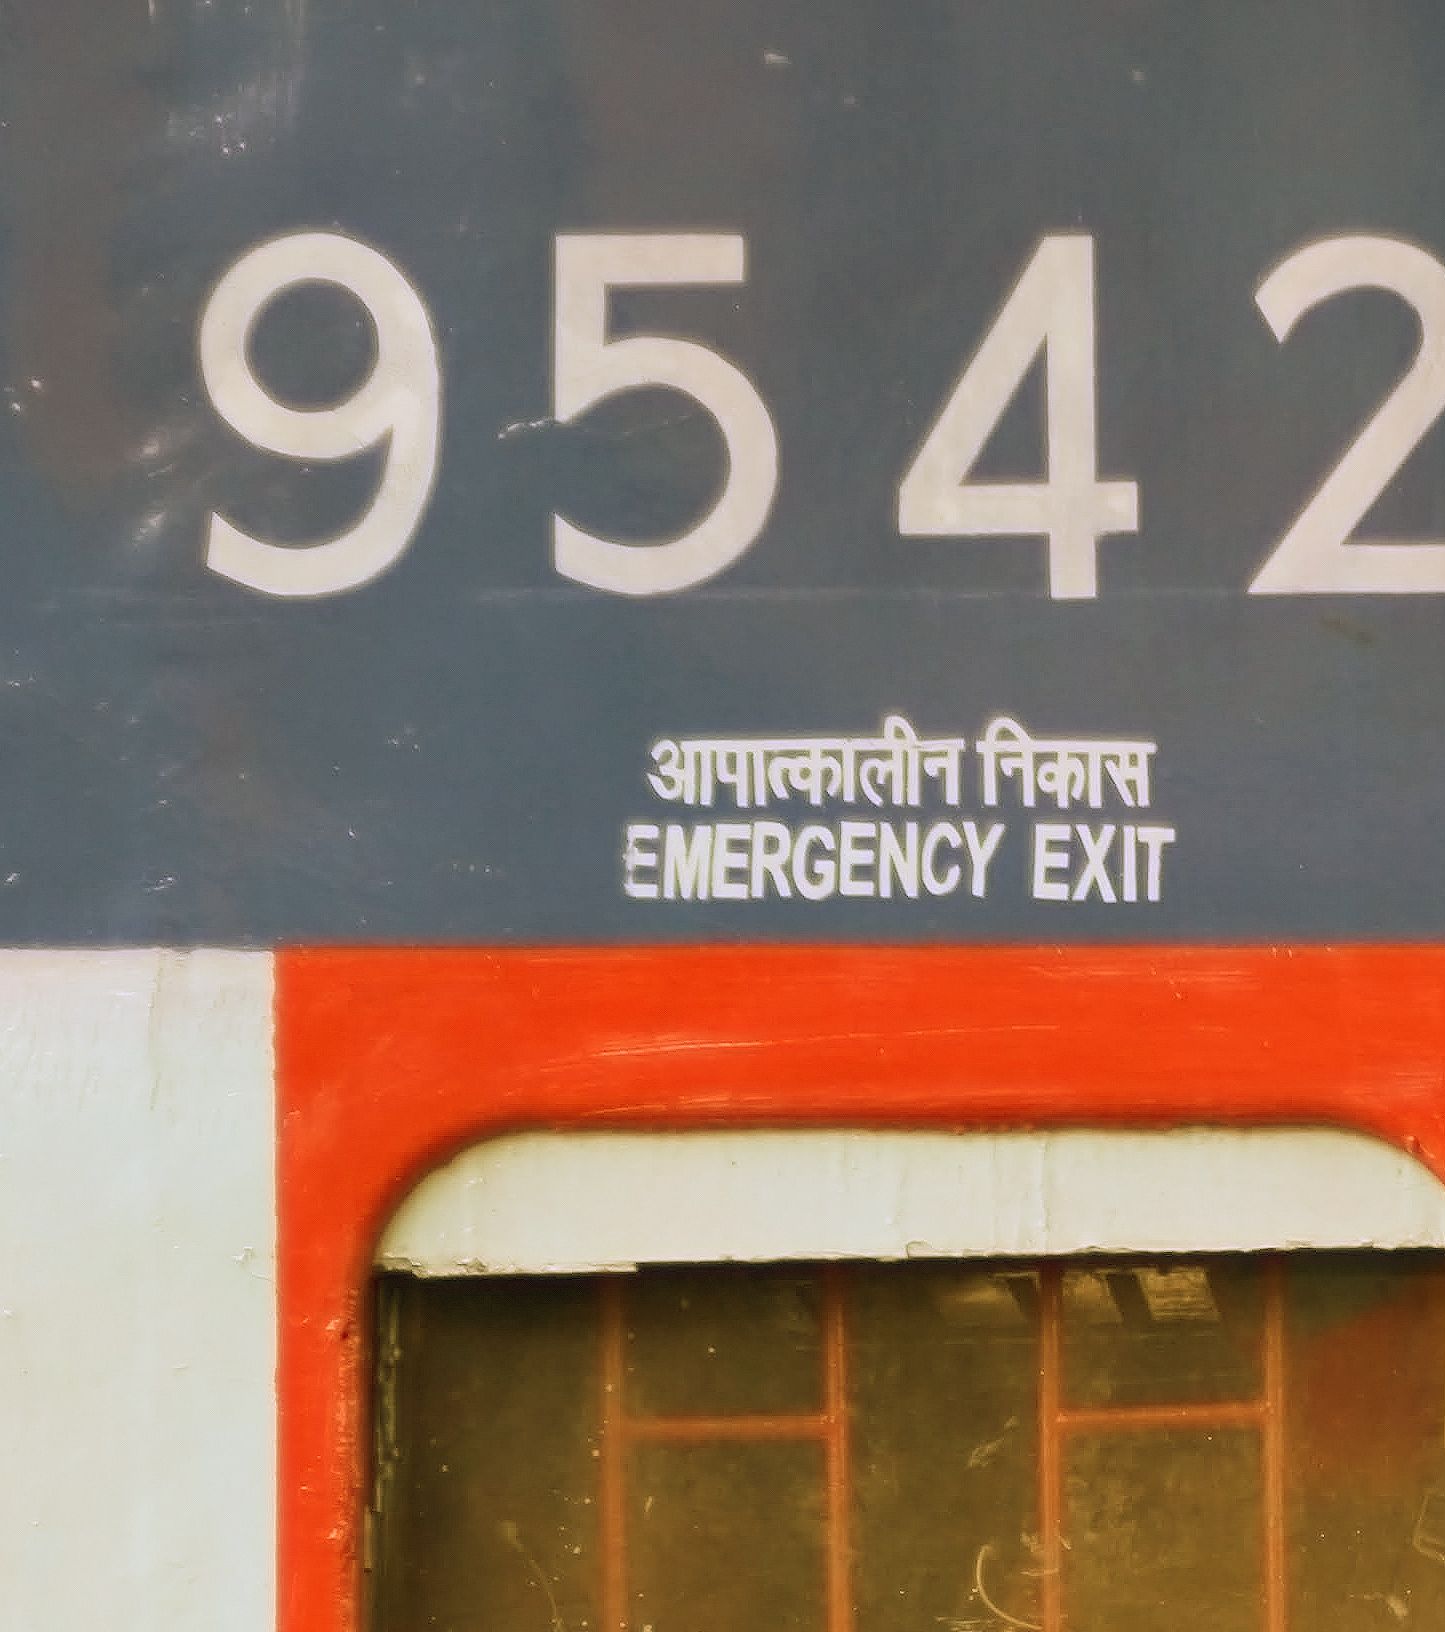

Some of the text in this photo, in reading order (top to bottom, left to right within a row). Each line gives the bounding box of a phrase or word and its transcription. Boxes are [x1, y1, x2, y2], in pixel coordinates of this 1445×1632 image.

[646, 714, 1158, 809] आपात्कालीन निकास
[622, 818, 1176, 902] EMERGENCY EXIT
